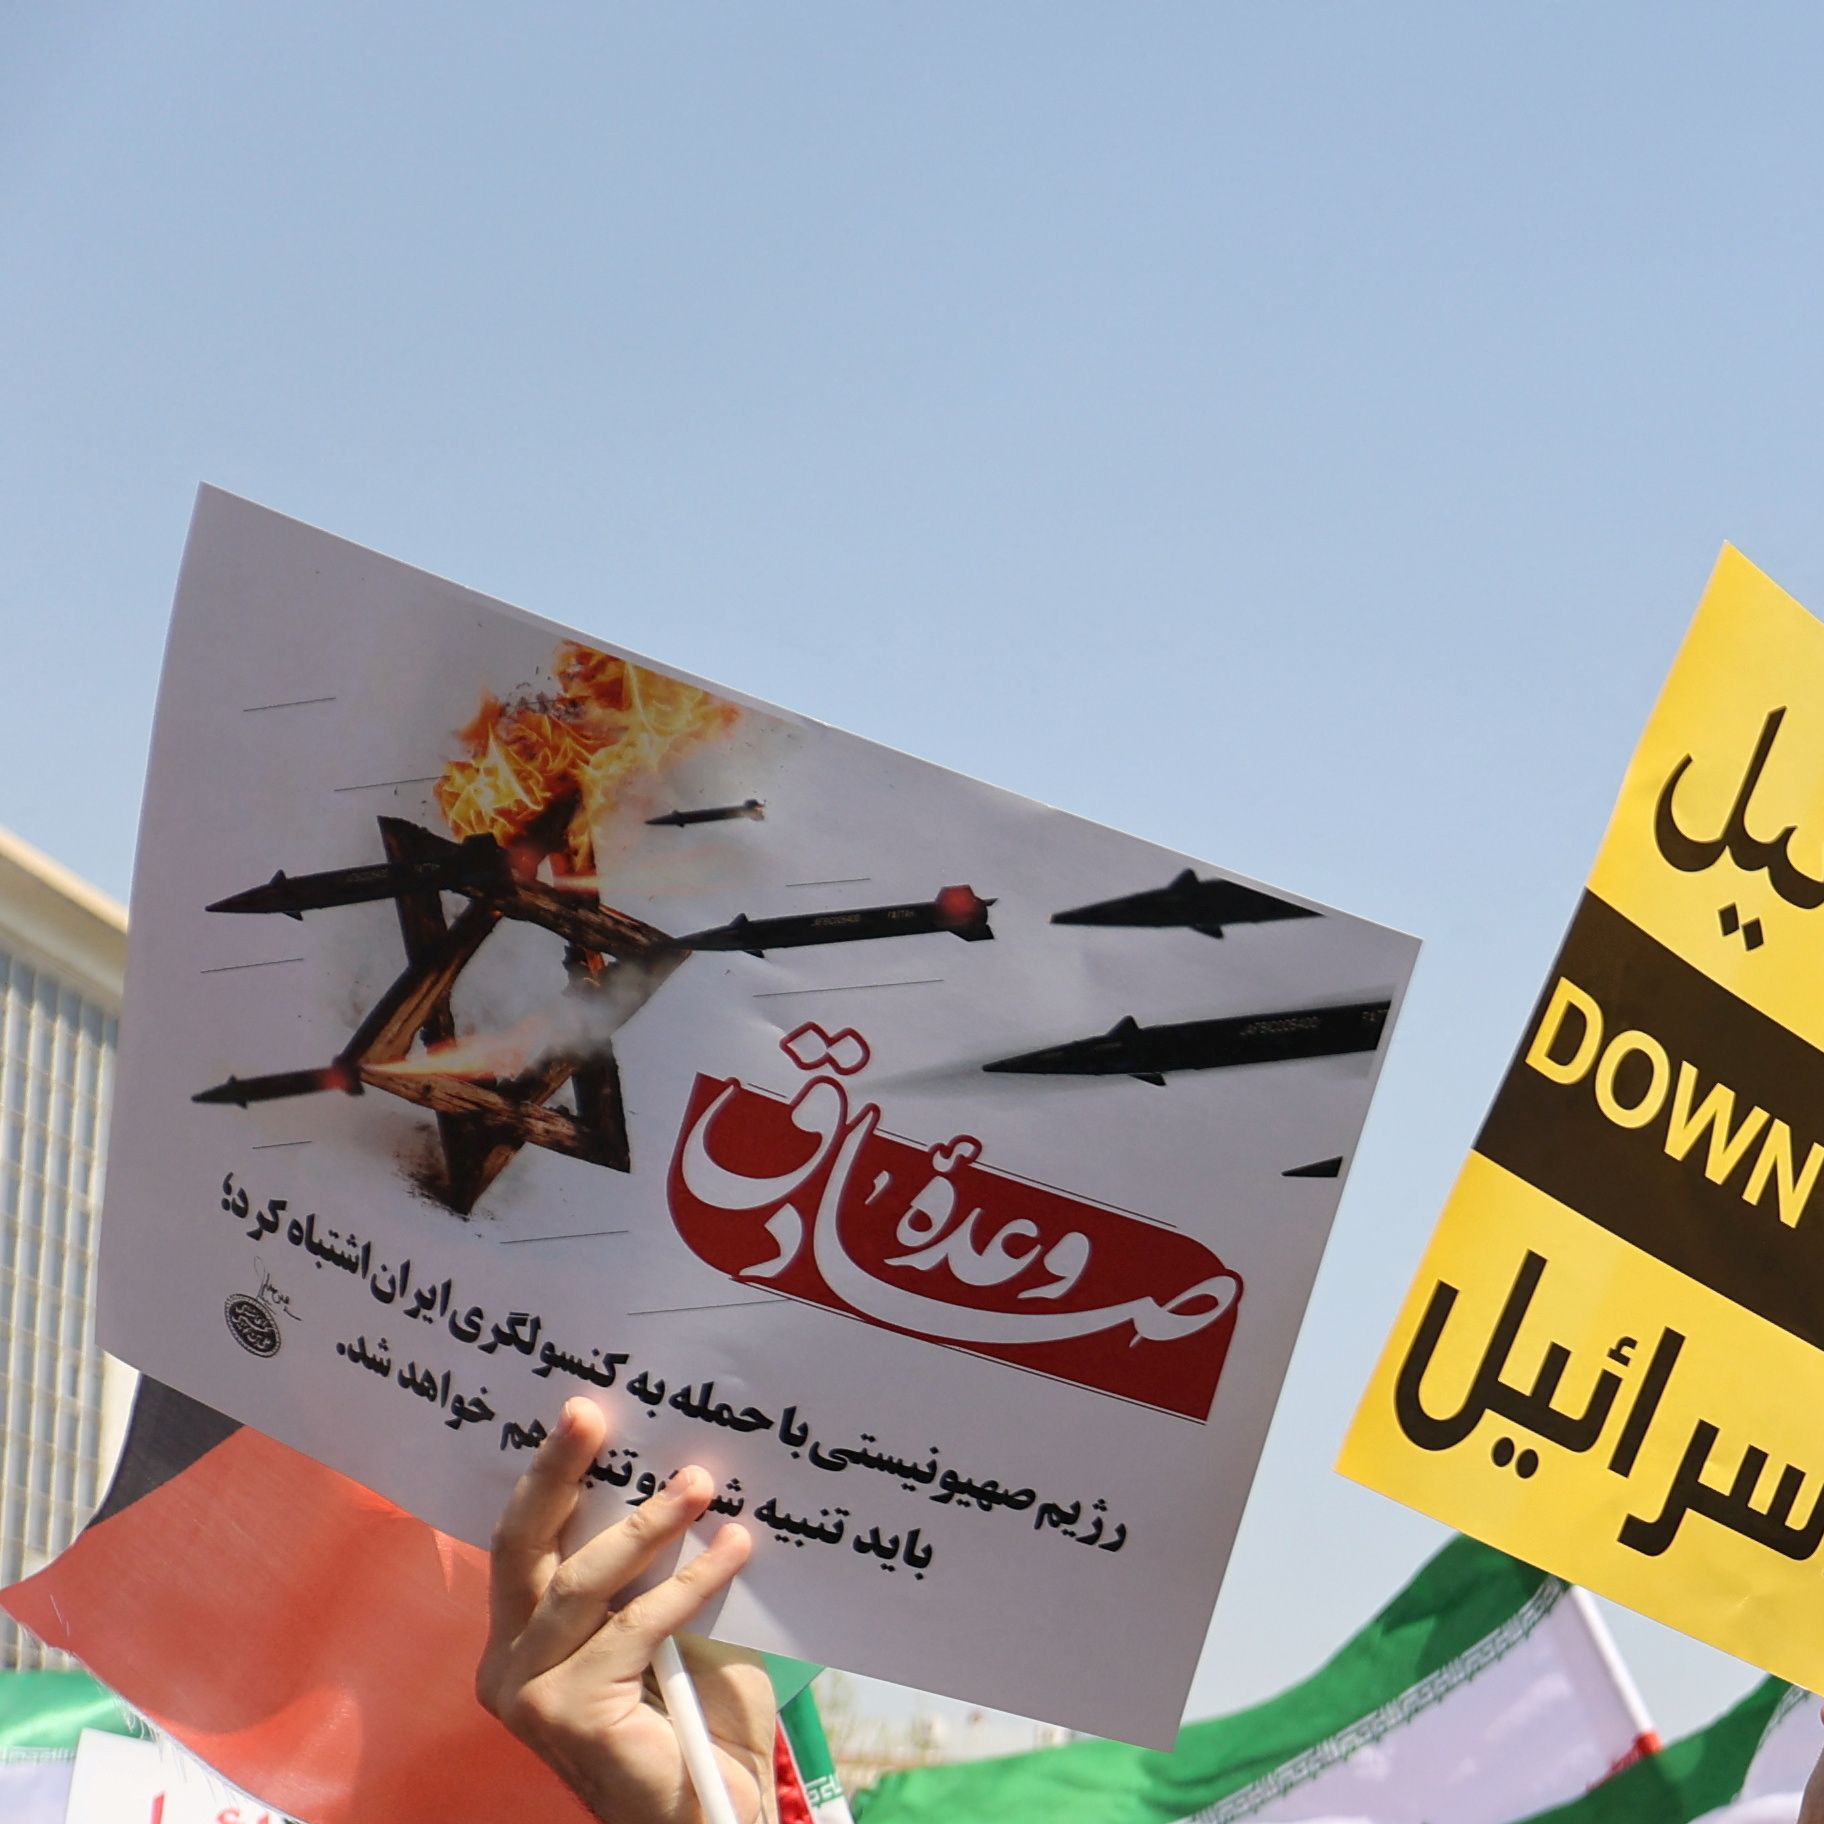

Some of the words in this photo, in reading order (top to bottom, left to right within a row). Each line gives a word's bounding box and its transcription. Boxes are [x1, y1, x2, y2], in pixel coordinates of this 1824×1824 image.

[286, 1213, 372, 1280] اشتباه
[369, 1259, 453, 1325] ایران
[448, 1306, 630, 1388] کنسولگری
[396, 1360, 496, 1431] خواهد
[626, 1370, 667, 1419] به
[668, 1381, 775, 1433] حمله
[777, 1405, 809, 1460] با
[808, 1433, 1037, 1512] صهیونیستی
[753, 1496, 851, 1548] تنبیه
[1033, 1498, 1128, 1553] رژیم
[852, 1525, 934, 1582] باید
